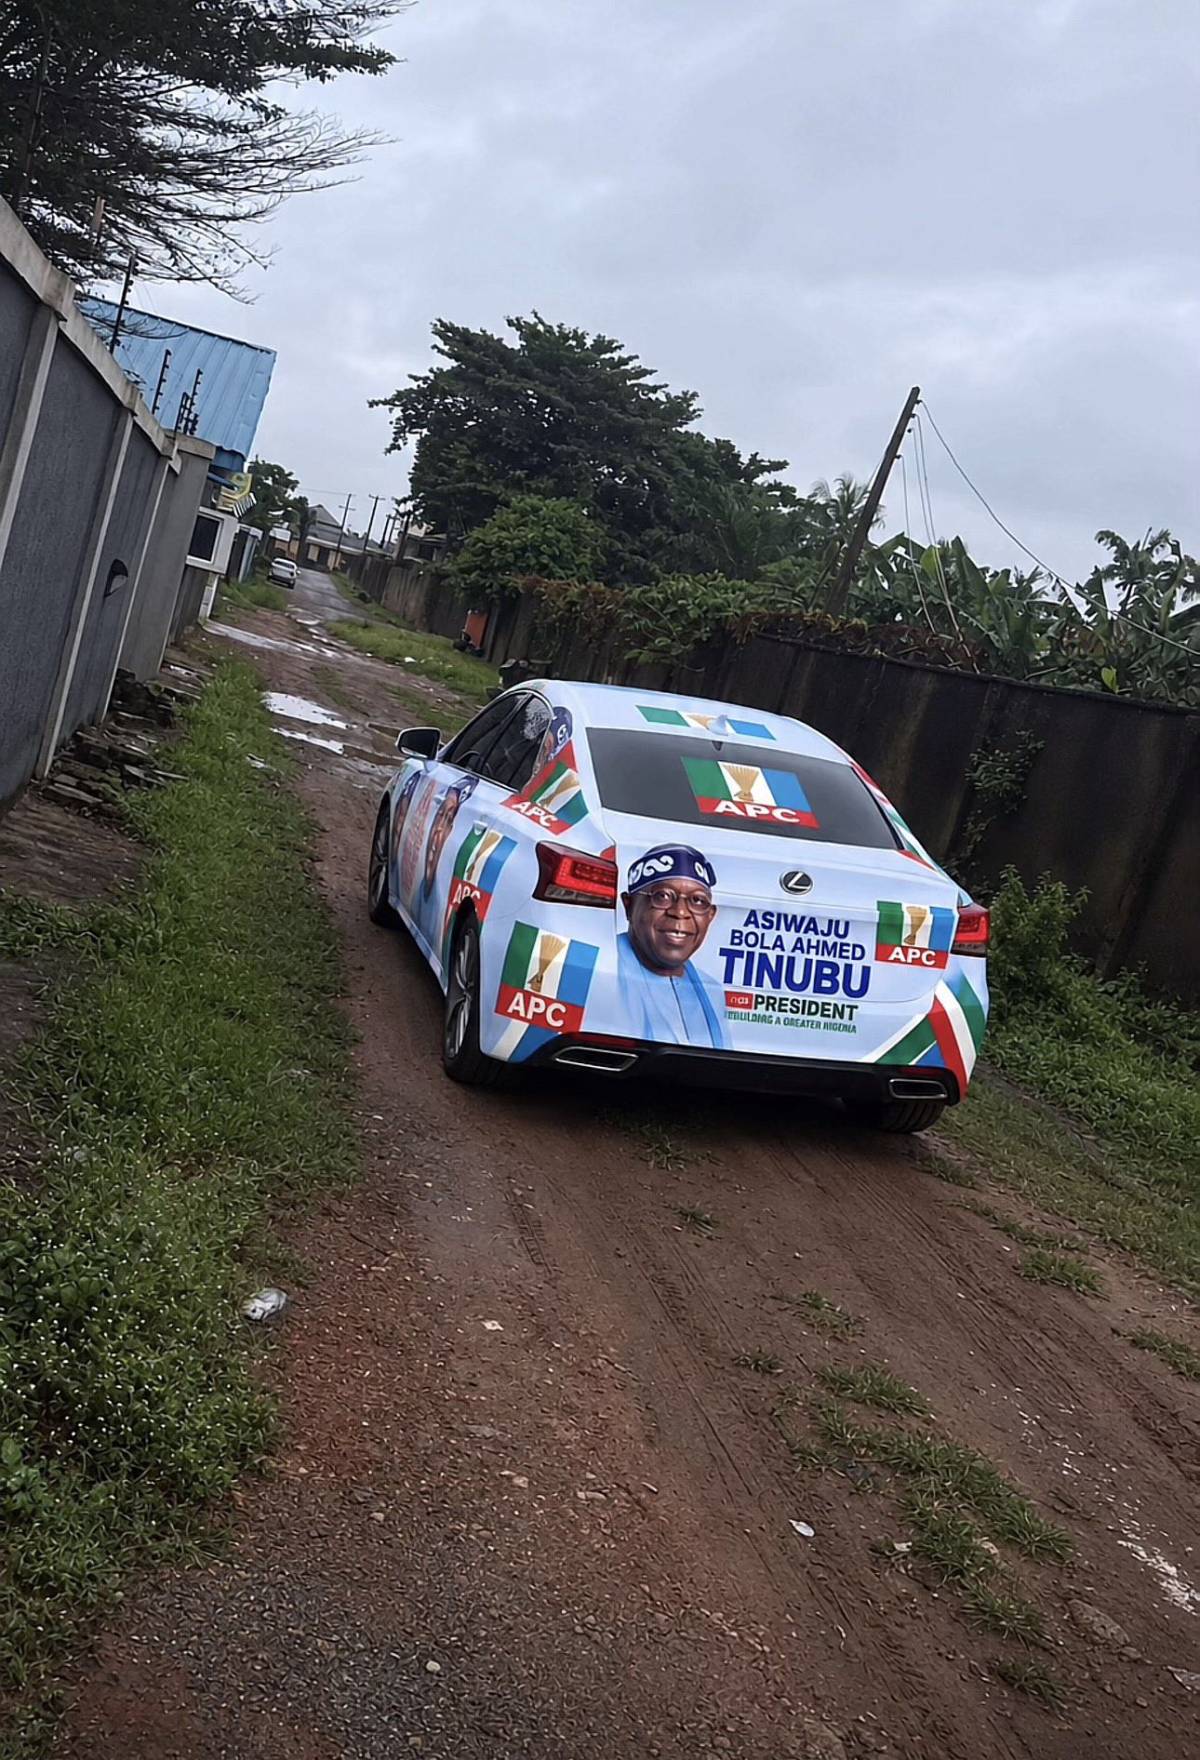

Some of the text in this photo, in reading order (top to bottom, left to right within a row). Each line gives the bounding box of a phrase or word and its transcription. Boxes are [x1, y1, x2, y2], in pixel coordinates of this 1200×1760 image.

[511, 801, 558, 827] APC
[714, 799, 800, 823] APC
[744, 909, 850, 939] ASIWAJU
[730, 929, 866, 961] BOLA AHMED
[888, 946, 936, 966] APC
[719, 947, 871, 999] TINUBU
[507, 992, 567, 1028] APC
[754, 993, 859, 1021] PRESIDENT
